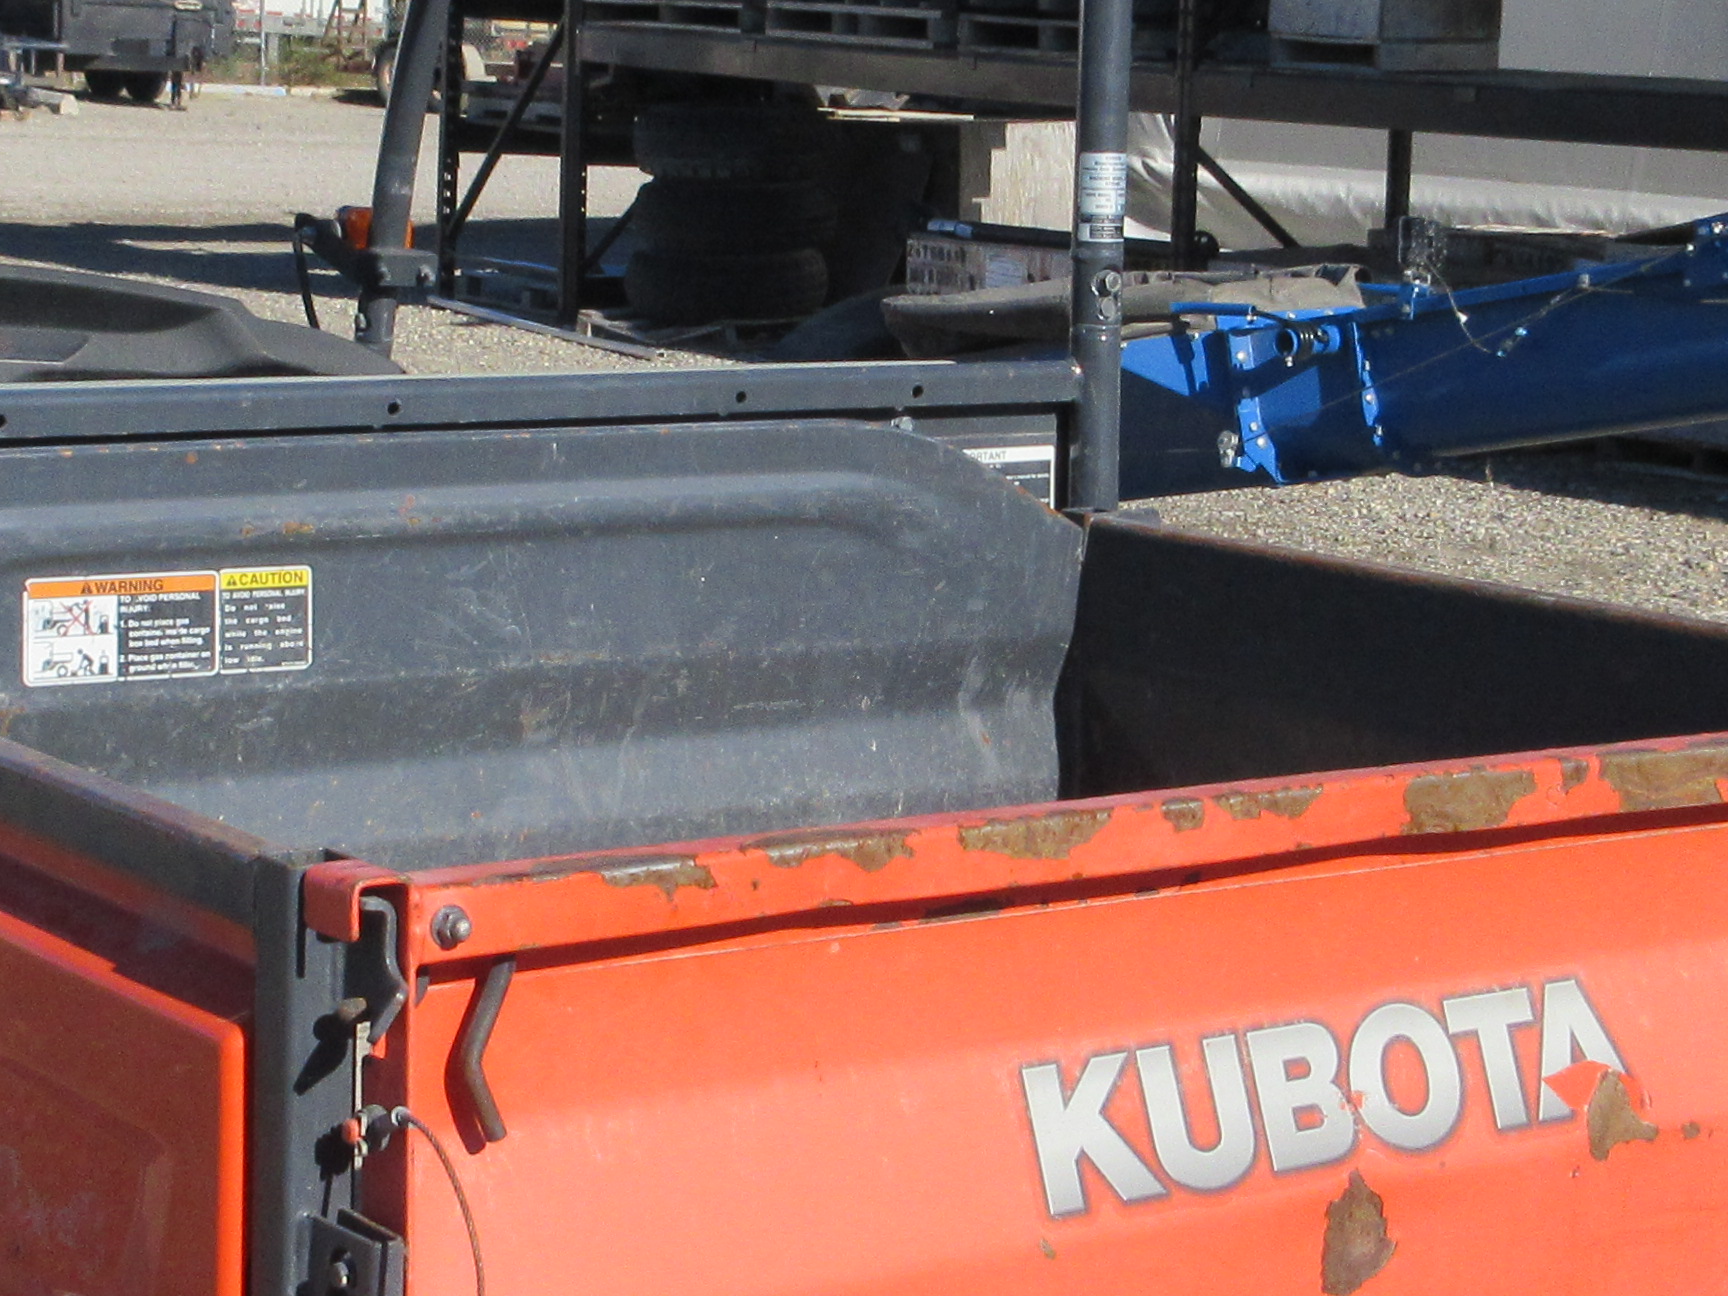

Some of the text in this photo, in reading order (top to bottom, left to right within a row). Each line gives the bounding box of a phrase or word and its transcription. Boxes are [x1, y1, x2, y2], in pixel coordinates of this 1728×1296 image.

[94, 578, 164, 593] WARNING
[239, 571, 303, 586] CAUTION
[135, 593, 157, 602] VOID
[158, 592, 201, 601] PERSONAL
[1021, 979, 1626, 1216] KUBOTA
